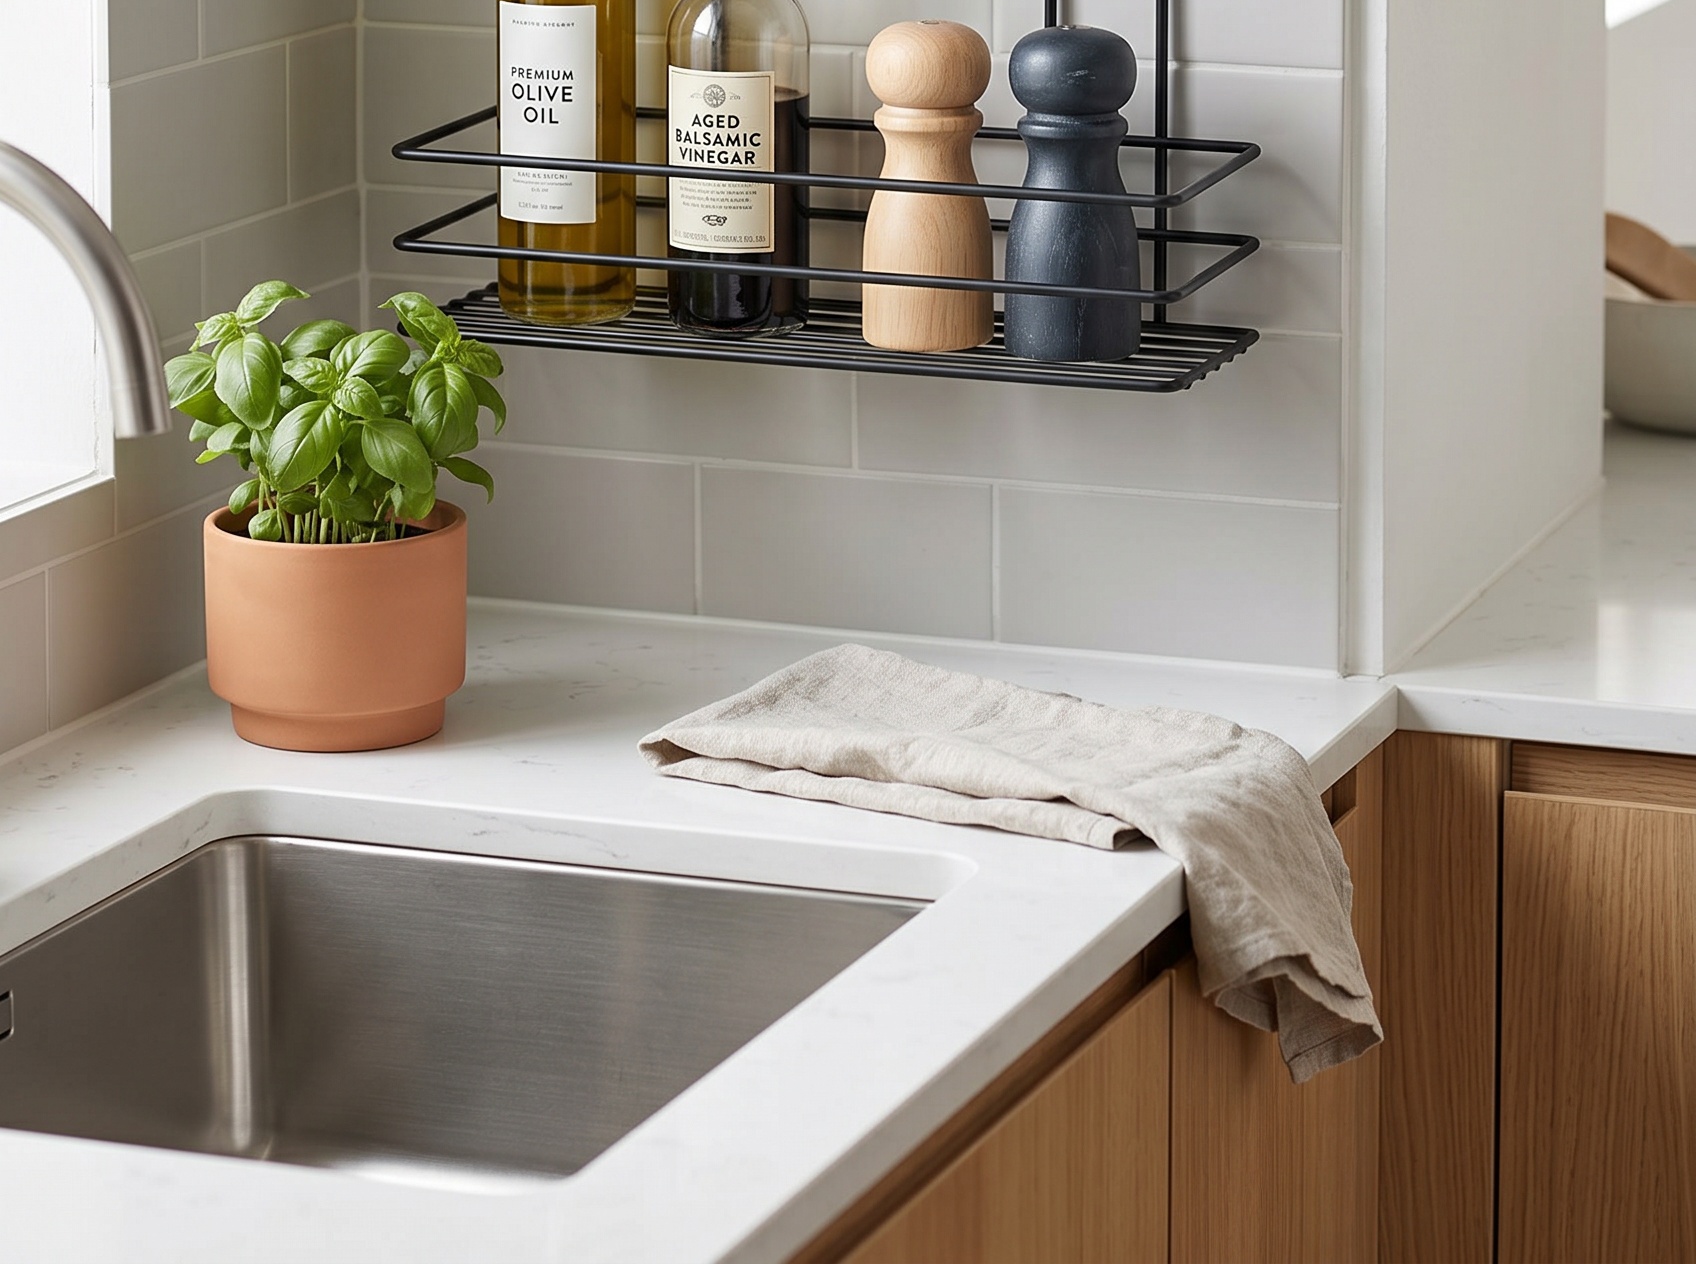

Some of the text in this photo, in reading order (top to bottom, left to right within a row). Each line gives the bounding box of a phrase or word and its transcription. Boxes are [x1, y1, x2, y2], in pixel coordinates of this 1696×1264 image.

[511, 66, 574, 81] PREMIUM
[511, 83, 573, 102] OLIVE
[523, 106, 559, 124] OIL
[691, 113, 740, 129] AGED
[675, 128, 761, 147] BALSAMIC
[679, 146, 756, 165] VINEGAR
